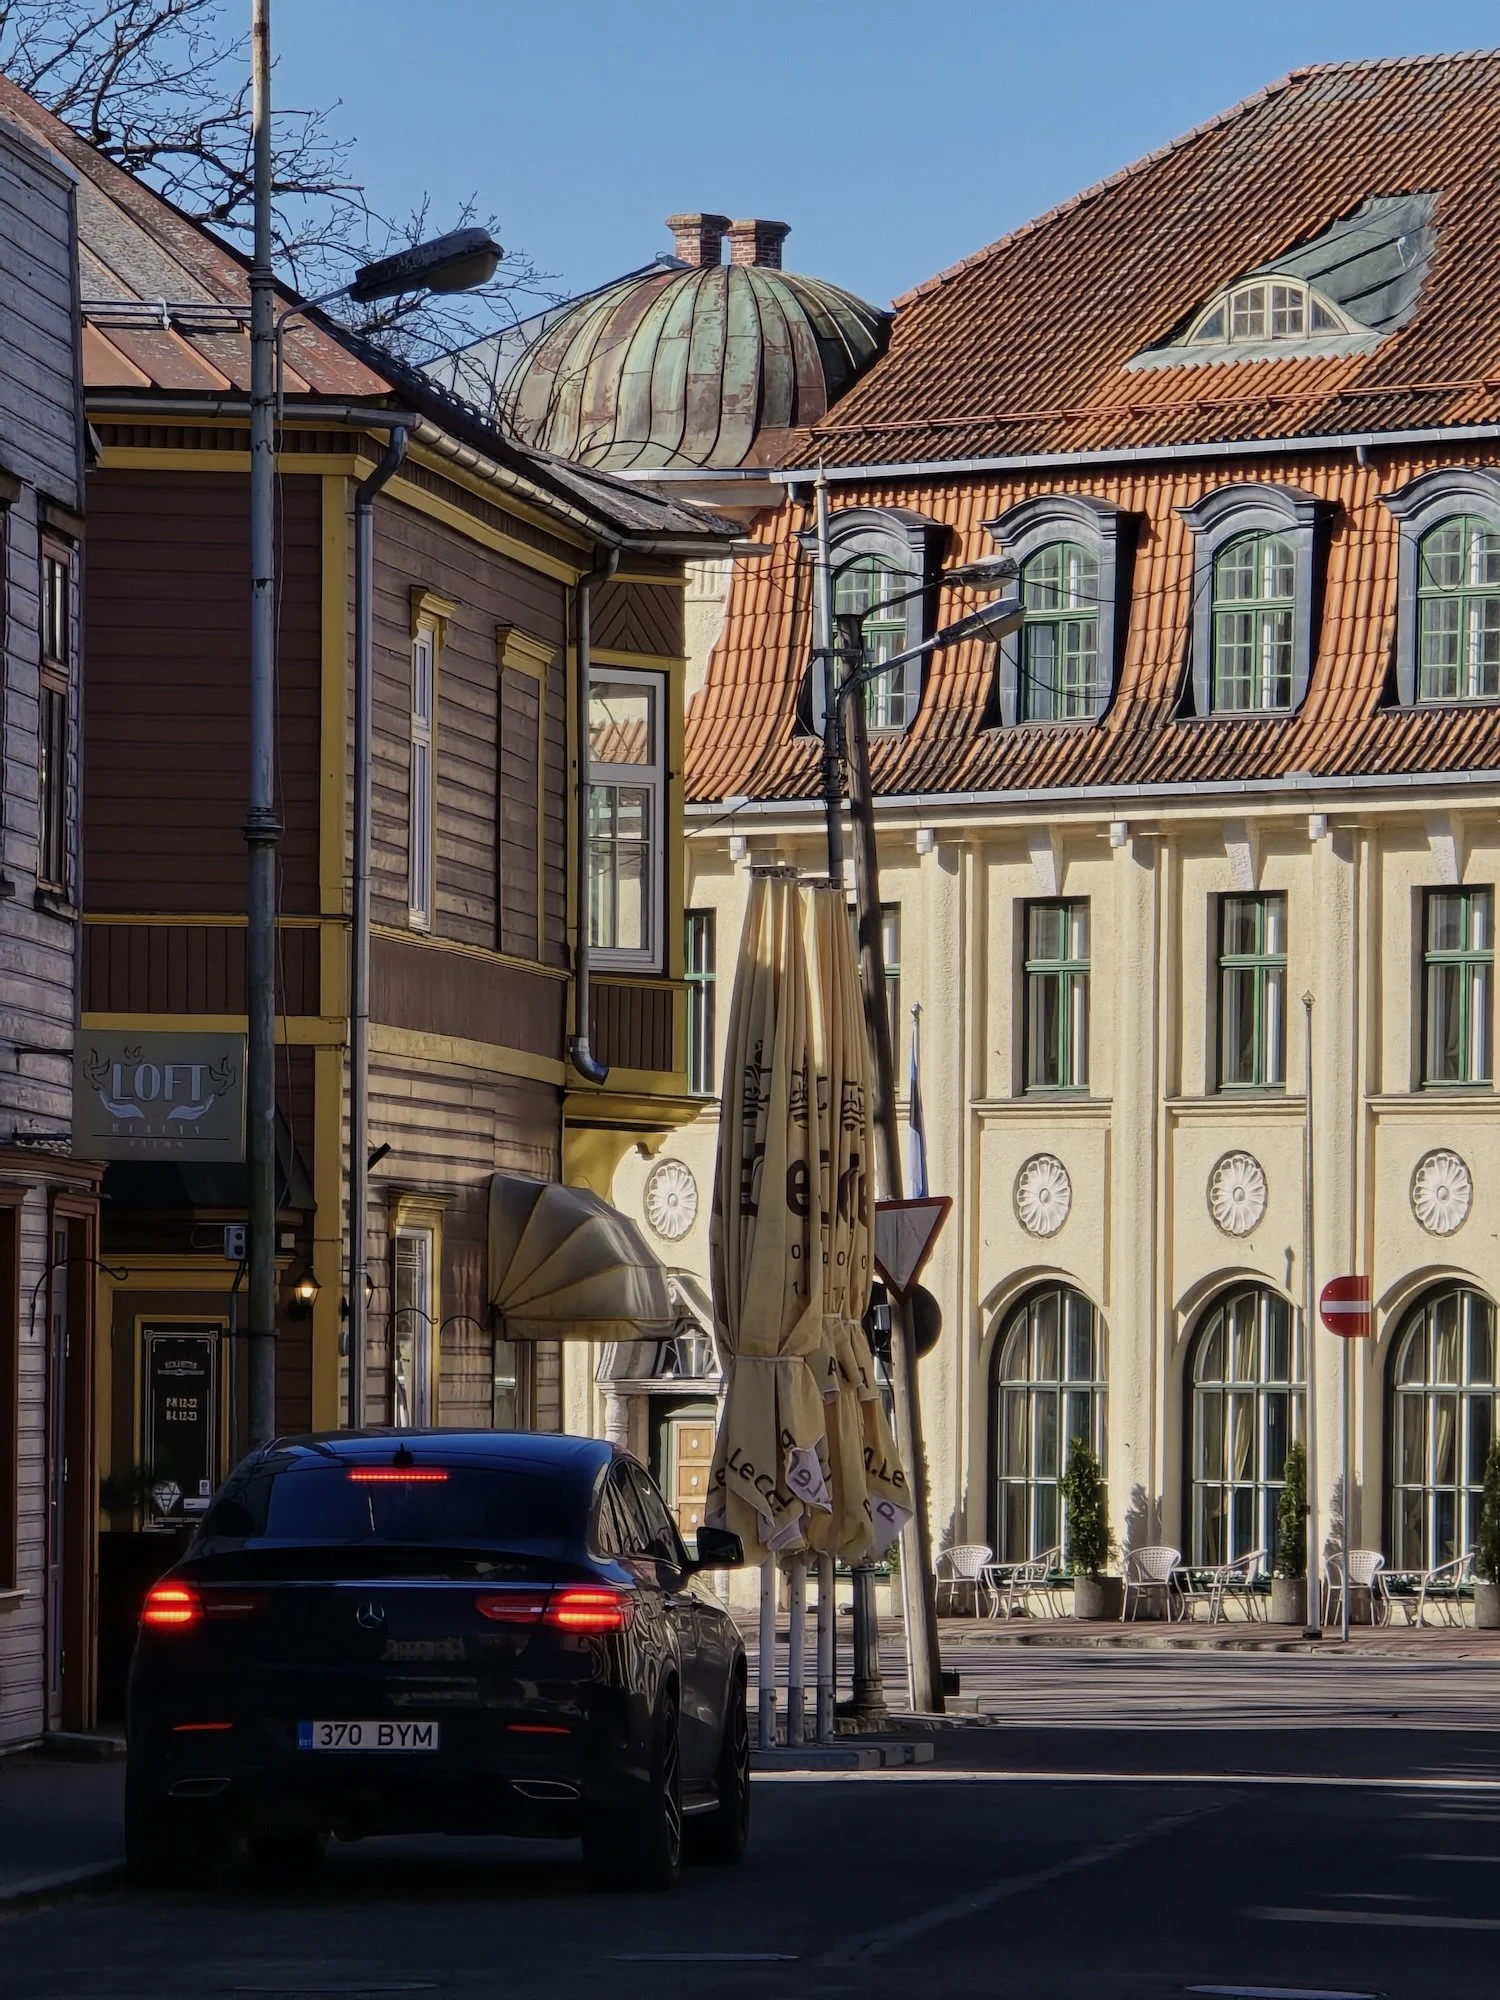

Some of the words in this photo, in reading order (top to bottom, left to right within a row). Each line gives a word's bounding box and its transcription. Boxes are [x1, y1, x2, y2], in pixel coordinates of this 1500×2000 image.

[112, 1063, 209, 1102] LOFT
[320, 1724, 362, 1746] 370
[378, 1724, 433, 1747] BYM
